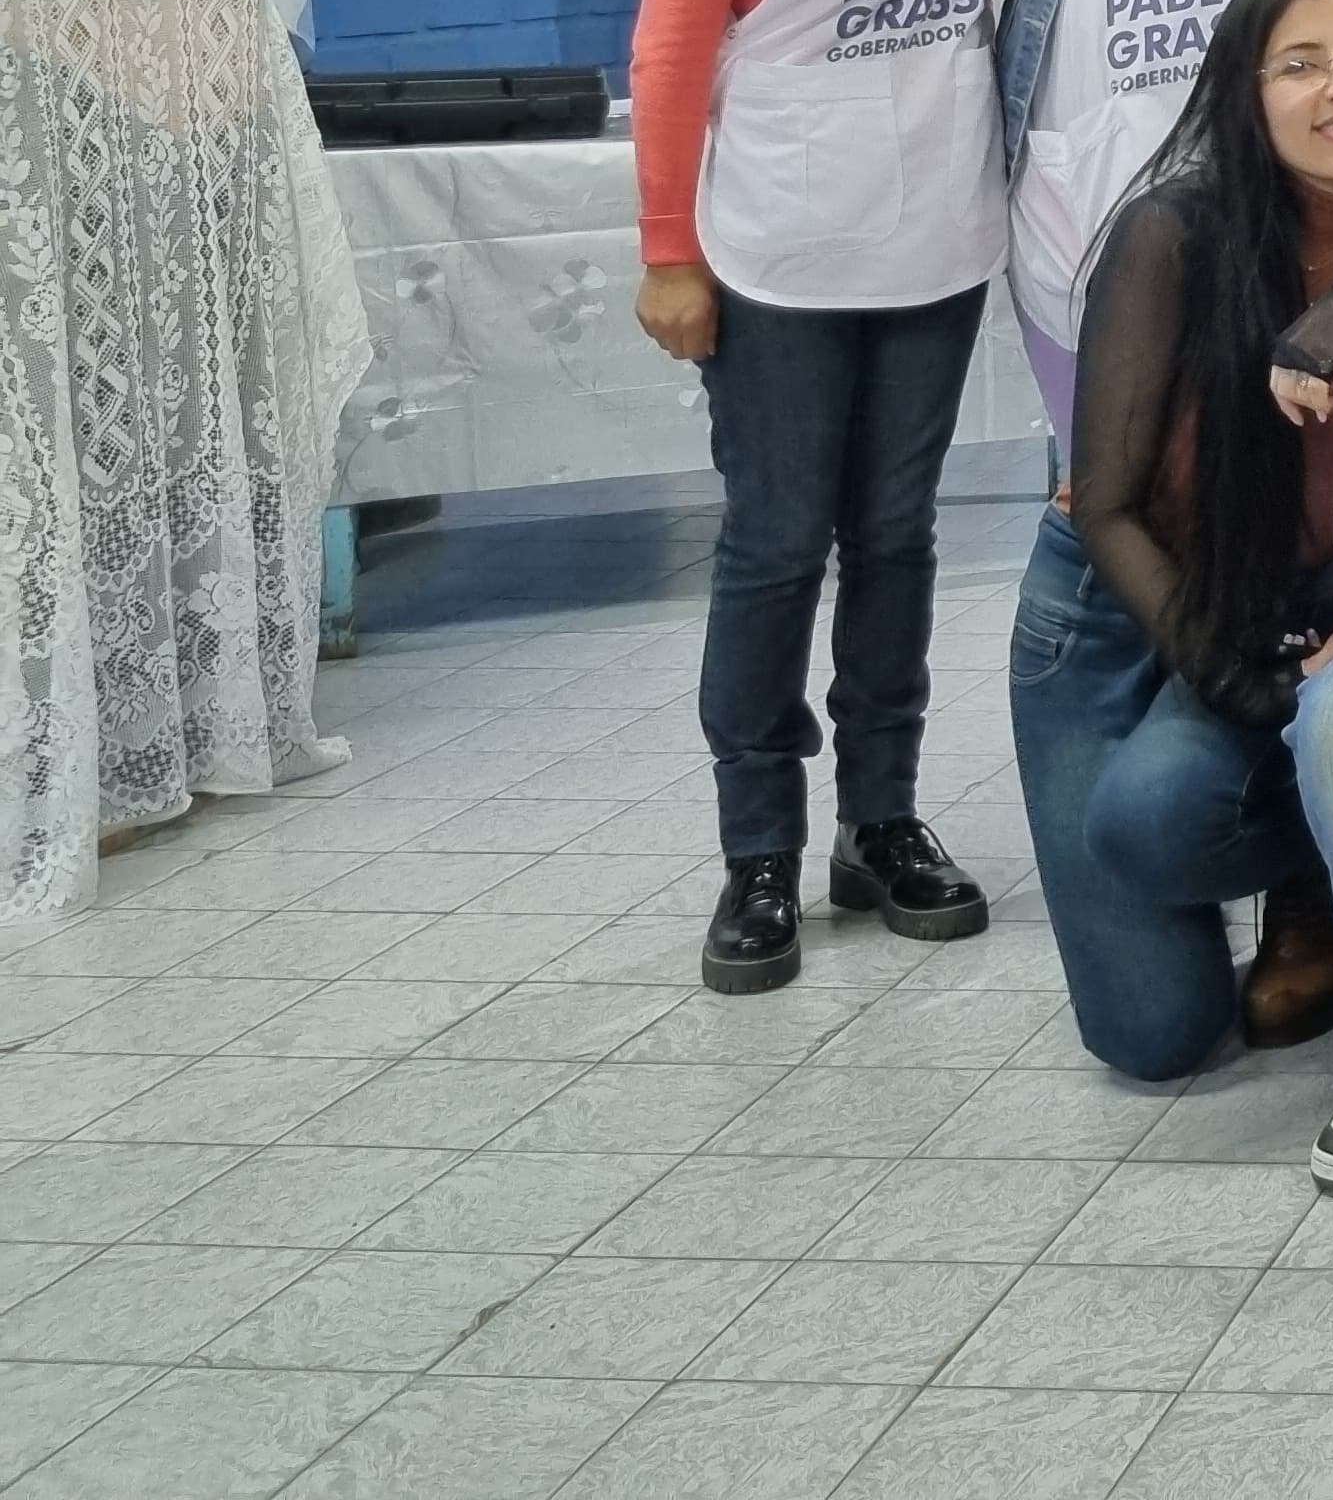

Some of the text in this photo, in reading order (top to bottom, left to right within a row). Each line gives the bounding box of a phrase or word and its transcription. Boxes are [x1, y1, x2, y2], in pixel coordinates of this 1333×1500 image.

[826, 22, 966, 62] GOBERNADOR
[1107, 11, 1226, 70] GRA
[1112, 62, 1201, 95] GOBERNA
